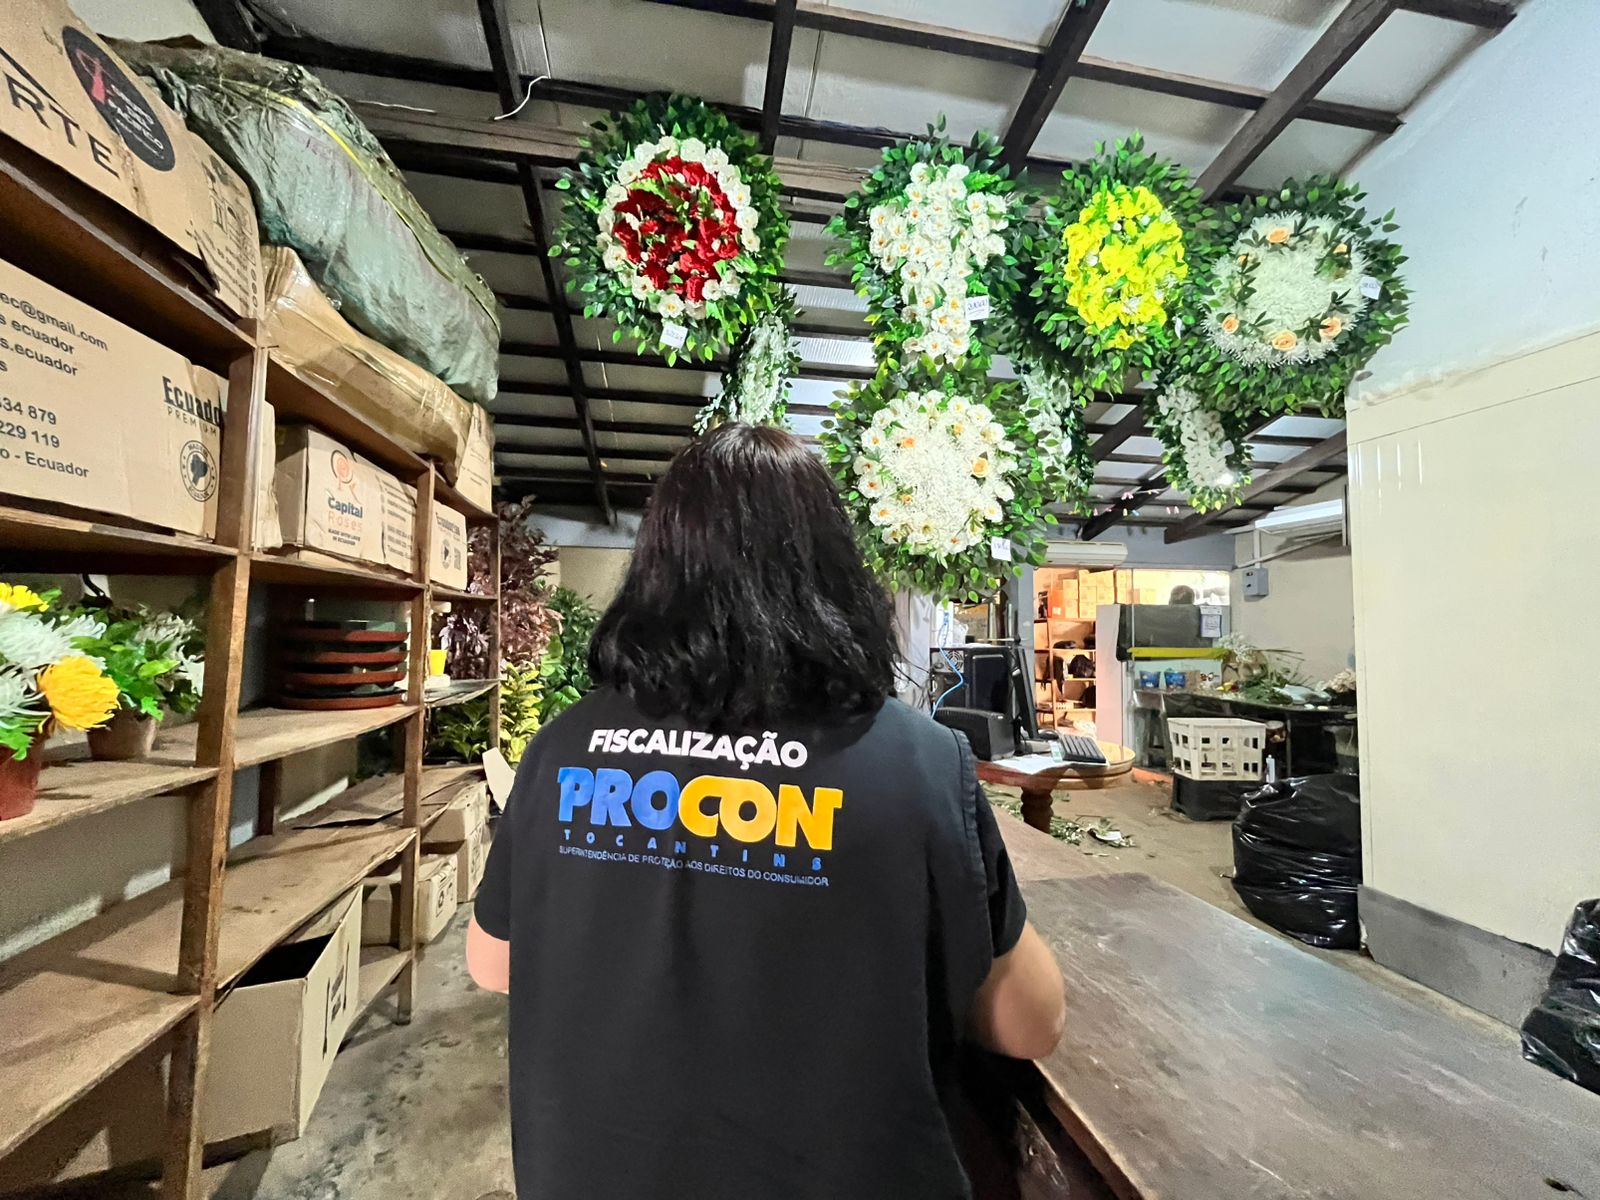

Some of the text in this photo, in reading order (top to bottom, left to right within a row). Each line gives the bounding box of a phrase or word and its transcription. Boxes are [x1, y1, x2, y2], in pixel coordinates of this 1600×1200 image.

[3, 70, 121, 180] RTE
[0, 292, 109, 351] ec@gmail.com
[11, 319, 75, 355] ecuador
[0, 337, 78, 376] s.ecuador
[0, 397, 57, 425] 34 879
[31, 430, 60, 448] 119
[25, 450, 90, 478] Ecuador
[328, 497, 363, 519] Capital
[587, 728, 808, 770] FISCALIZAÇÃO
[556, 766, 844, 850] PROCON
[564, 829, 822, 871] TOCANTINS
[627, 853, 640, 863] DE
[704, 863, 746, 878] DIREITOS
[747, 869, 762, 879] DO
